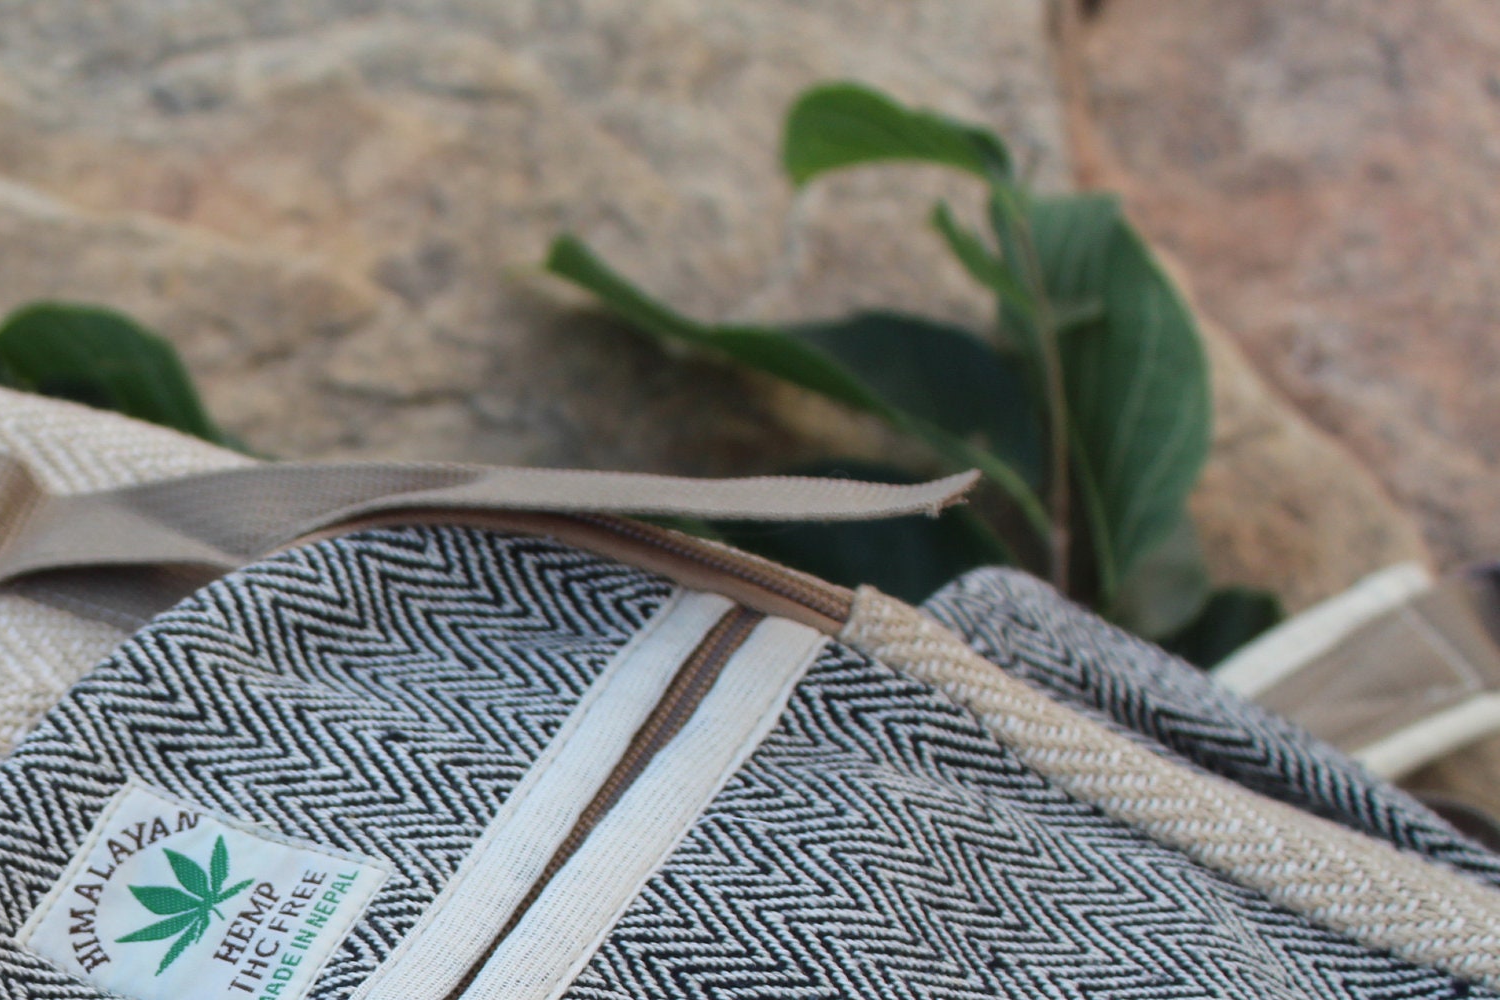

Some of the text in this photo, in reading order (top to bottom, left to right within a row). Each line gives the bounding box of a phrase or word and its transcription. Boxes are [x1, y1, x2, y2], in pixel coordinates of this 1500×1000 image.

[69, 810, 200, 974] HIMALAYAN
[213, 881, 281, 967] HEMP
[228, 869, 328, 994] THC FREE
[290, 928, 317, 951] IN
[305, 870, 359, 929] NEPAL
